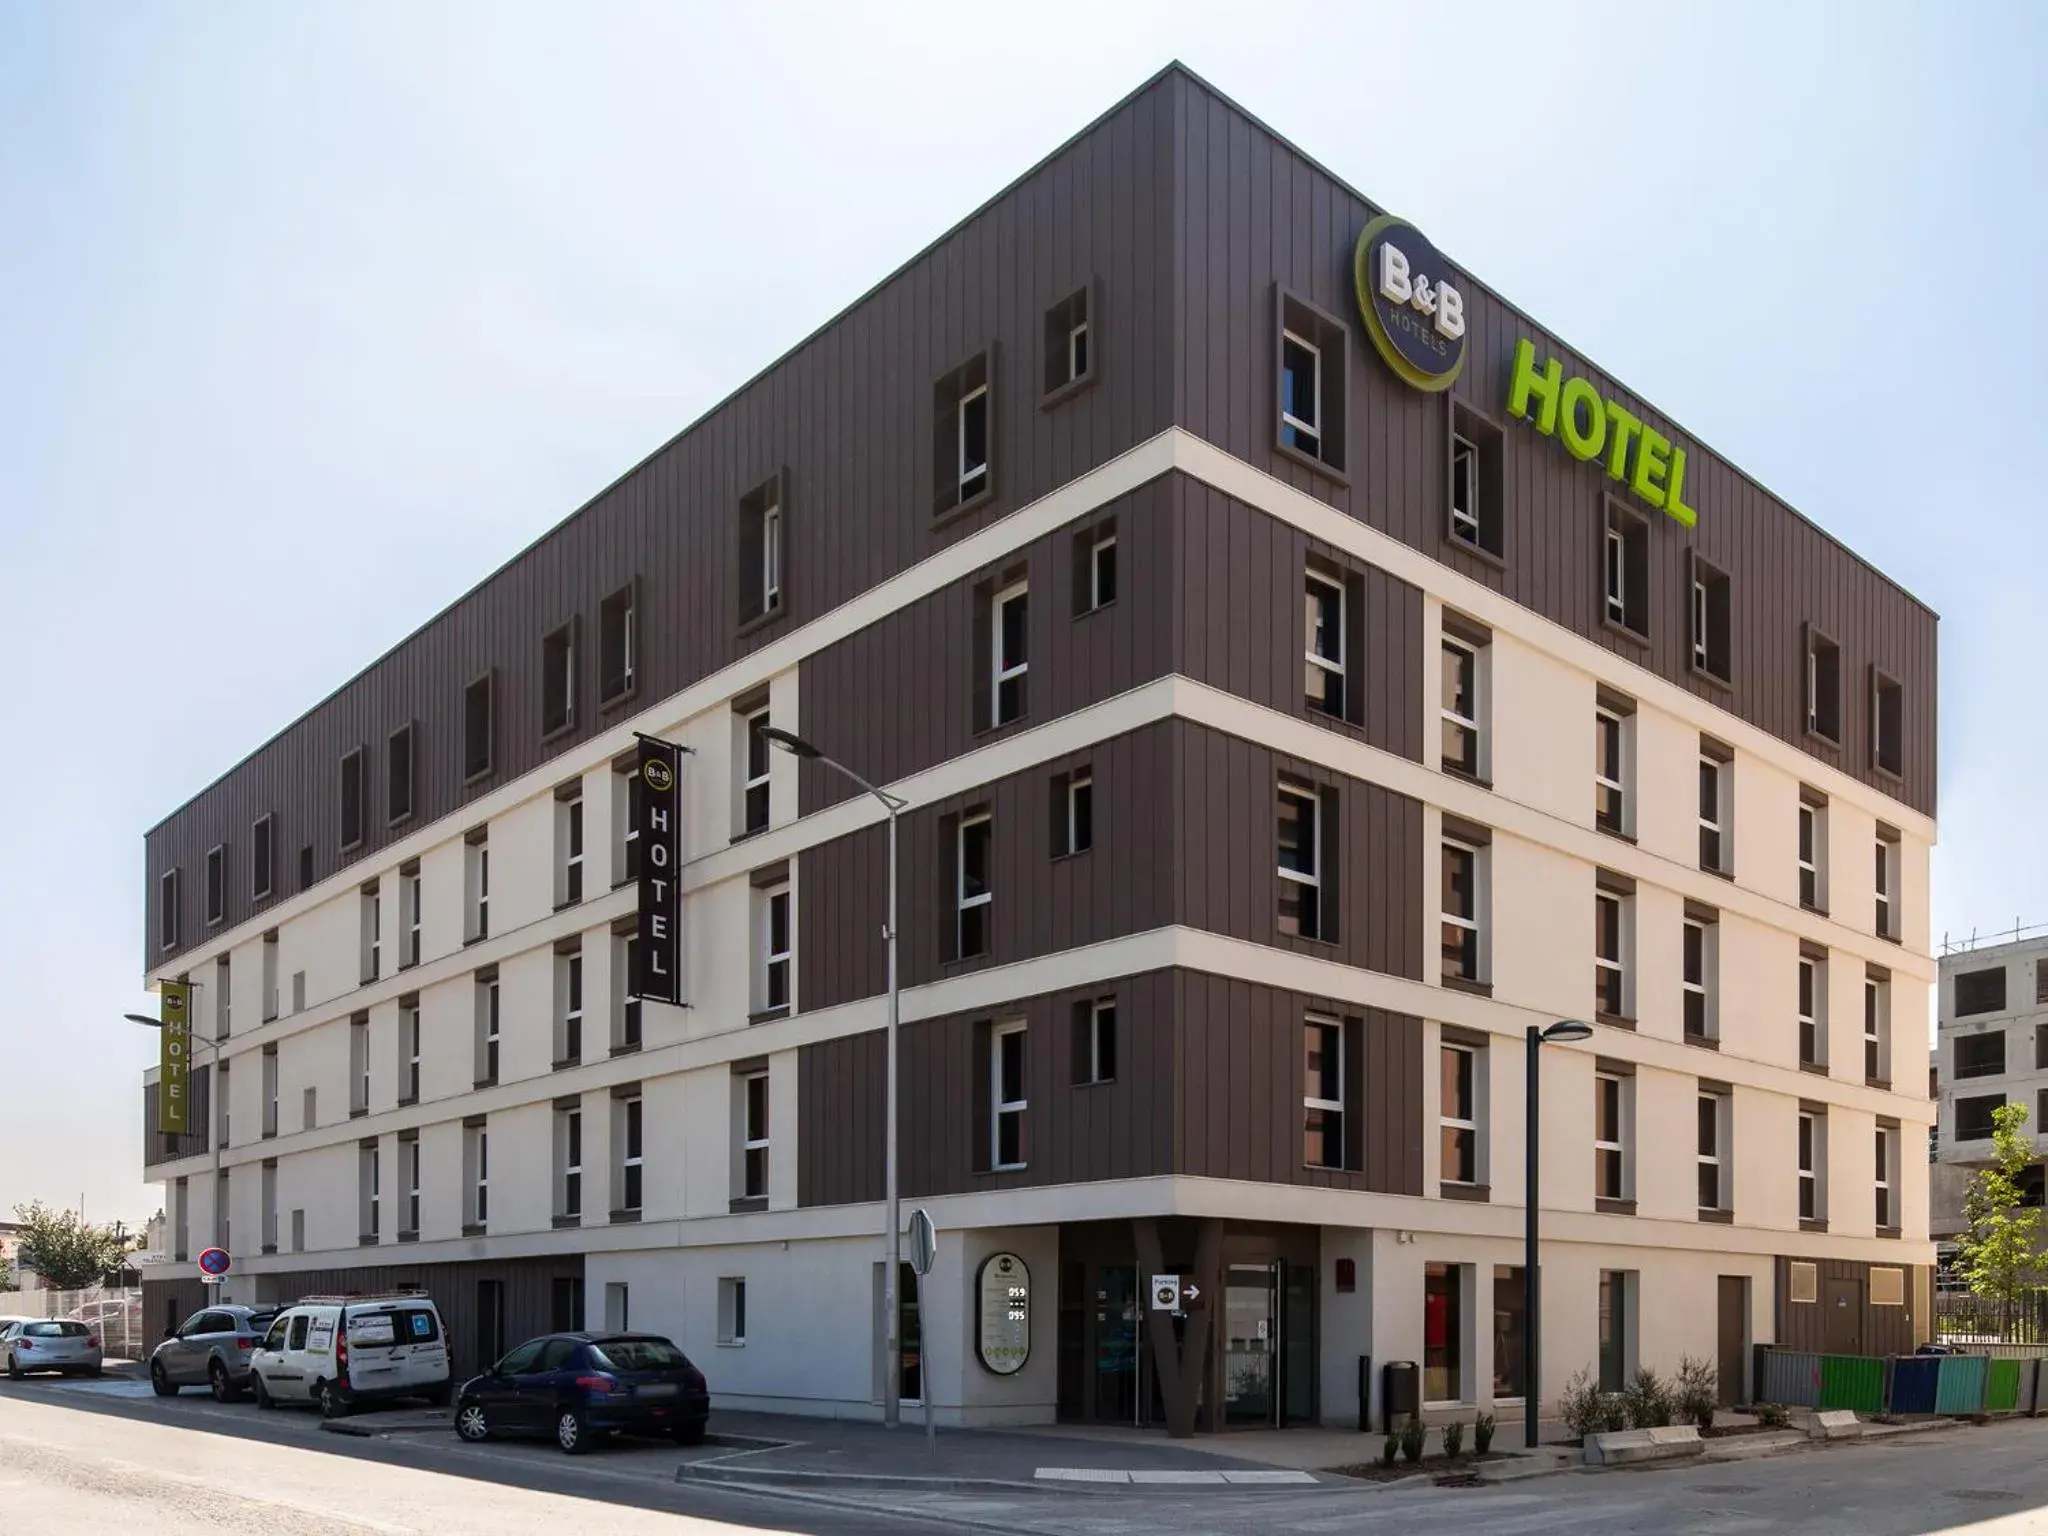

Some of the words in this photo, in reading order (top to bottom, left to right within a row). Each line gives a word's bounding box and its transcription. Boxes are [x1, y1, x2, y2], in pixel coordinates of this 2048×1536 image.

[1380, 241, 1466, 340] B&B
[1390, 308, 1447, 357] HOTELS
[1506, 337, 1698, 528] HOTEL
[651, 807, 668, 975] HOTEL
[168, 1020, 182, 1120] HOTEL
